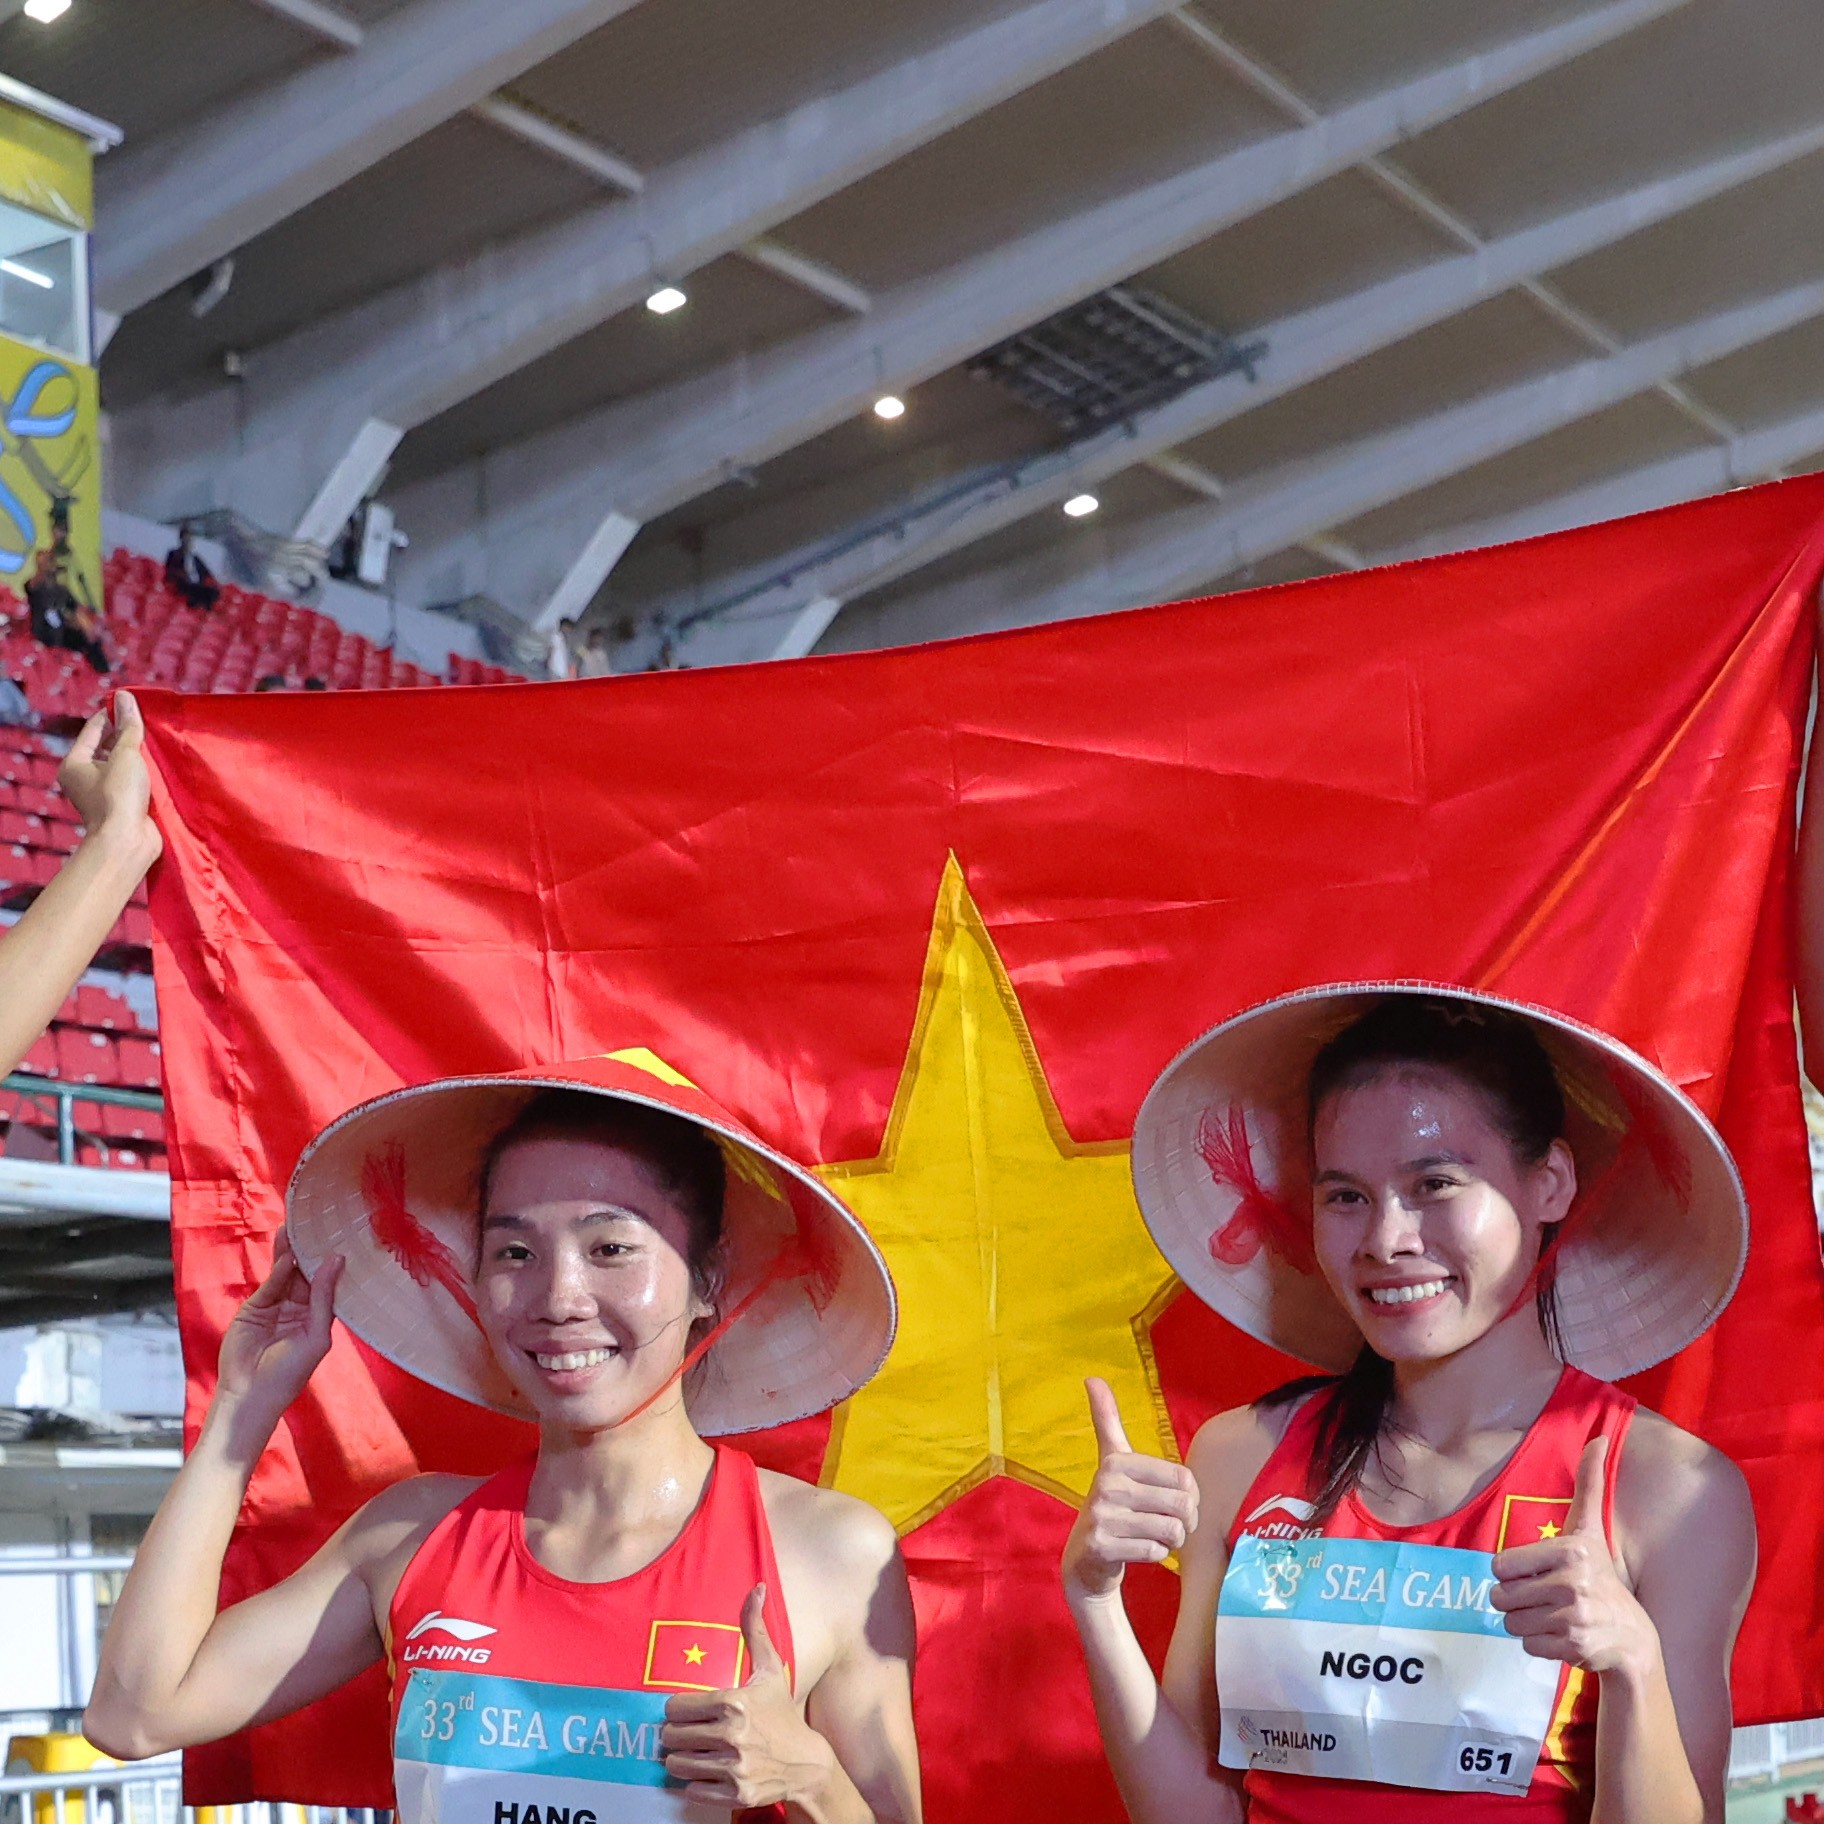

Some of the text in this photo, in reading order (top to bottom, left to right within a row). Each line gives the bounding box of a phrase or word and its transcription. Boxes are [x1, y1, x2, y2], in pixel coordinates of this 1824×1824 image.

[1320, 1564, 1386, 1603] SEA
[1402, 1571, 1507, 1615] GAM
[403, 1645, 491, 1663] LI-NING
[1320, 1651, 1424, 1684] NGOC
[421, 1690, 474, 1741] 33rd
[479, 1706, 549, 1750] SEA
[1260, 1729, 1337, 1752] THAILAND
[1459, 1747, 1513, 1775] 651
